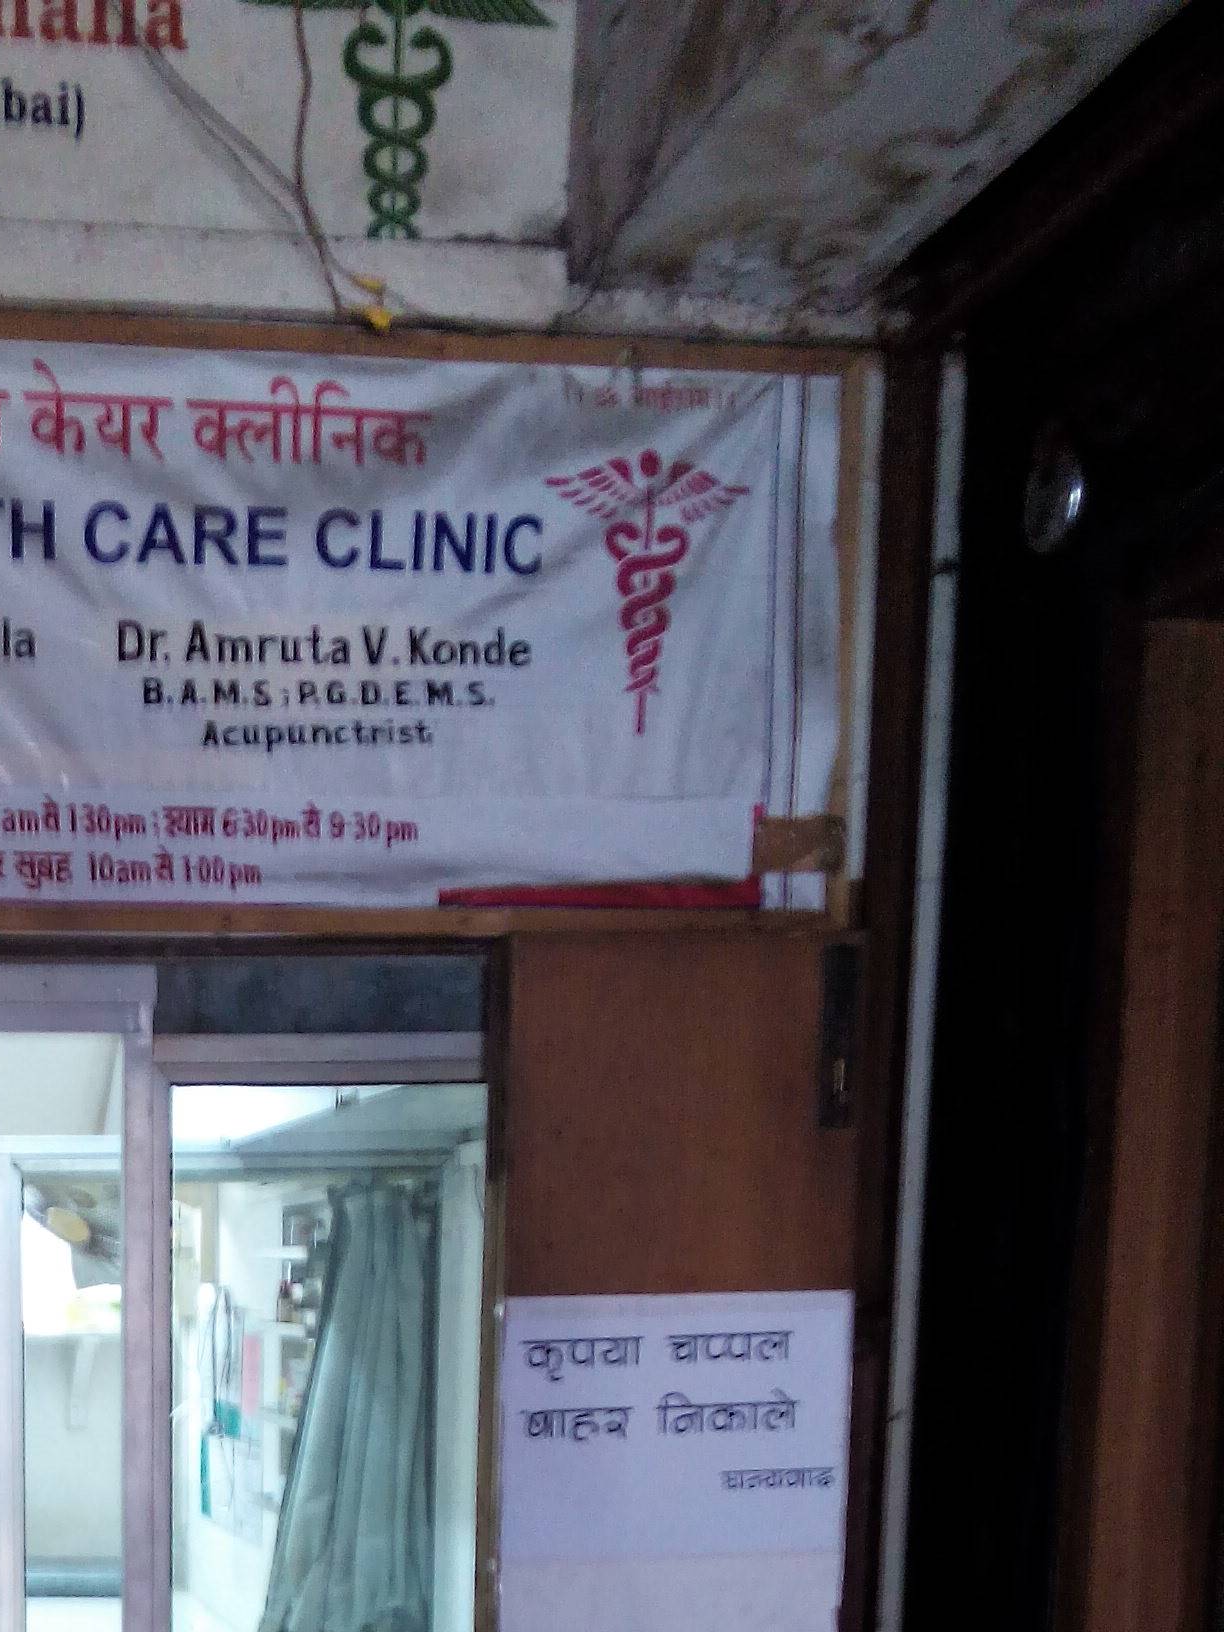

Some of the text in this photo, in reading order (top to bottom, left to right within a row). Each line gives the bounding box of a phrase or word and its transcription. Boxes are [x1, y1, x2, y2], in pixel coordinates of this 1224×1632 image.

[22, 358, 173, 463] केयर
[184, 376, 432, 467] क्लीनिक
[82, 501, 288, 568] CARE
[315, 509, 543, 576] CLINIC
[118, 618, 171, 665] Dr.
[184, 620, 351, 667] Amruta
[409, 625, 533, 668] Konde
[200, 718, 433, 753] Acupunctrist
[13, 850, 73, 892] सुबह
[522, 1335, 645, 1383] कृपया
